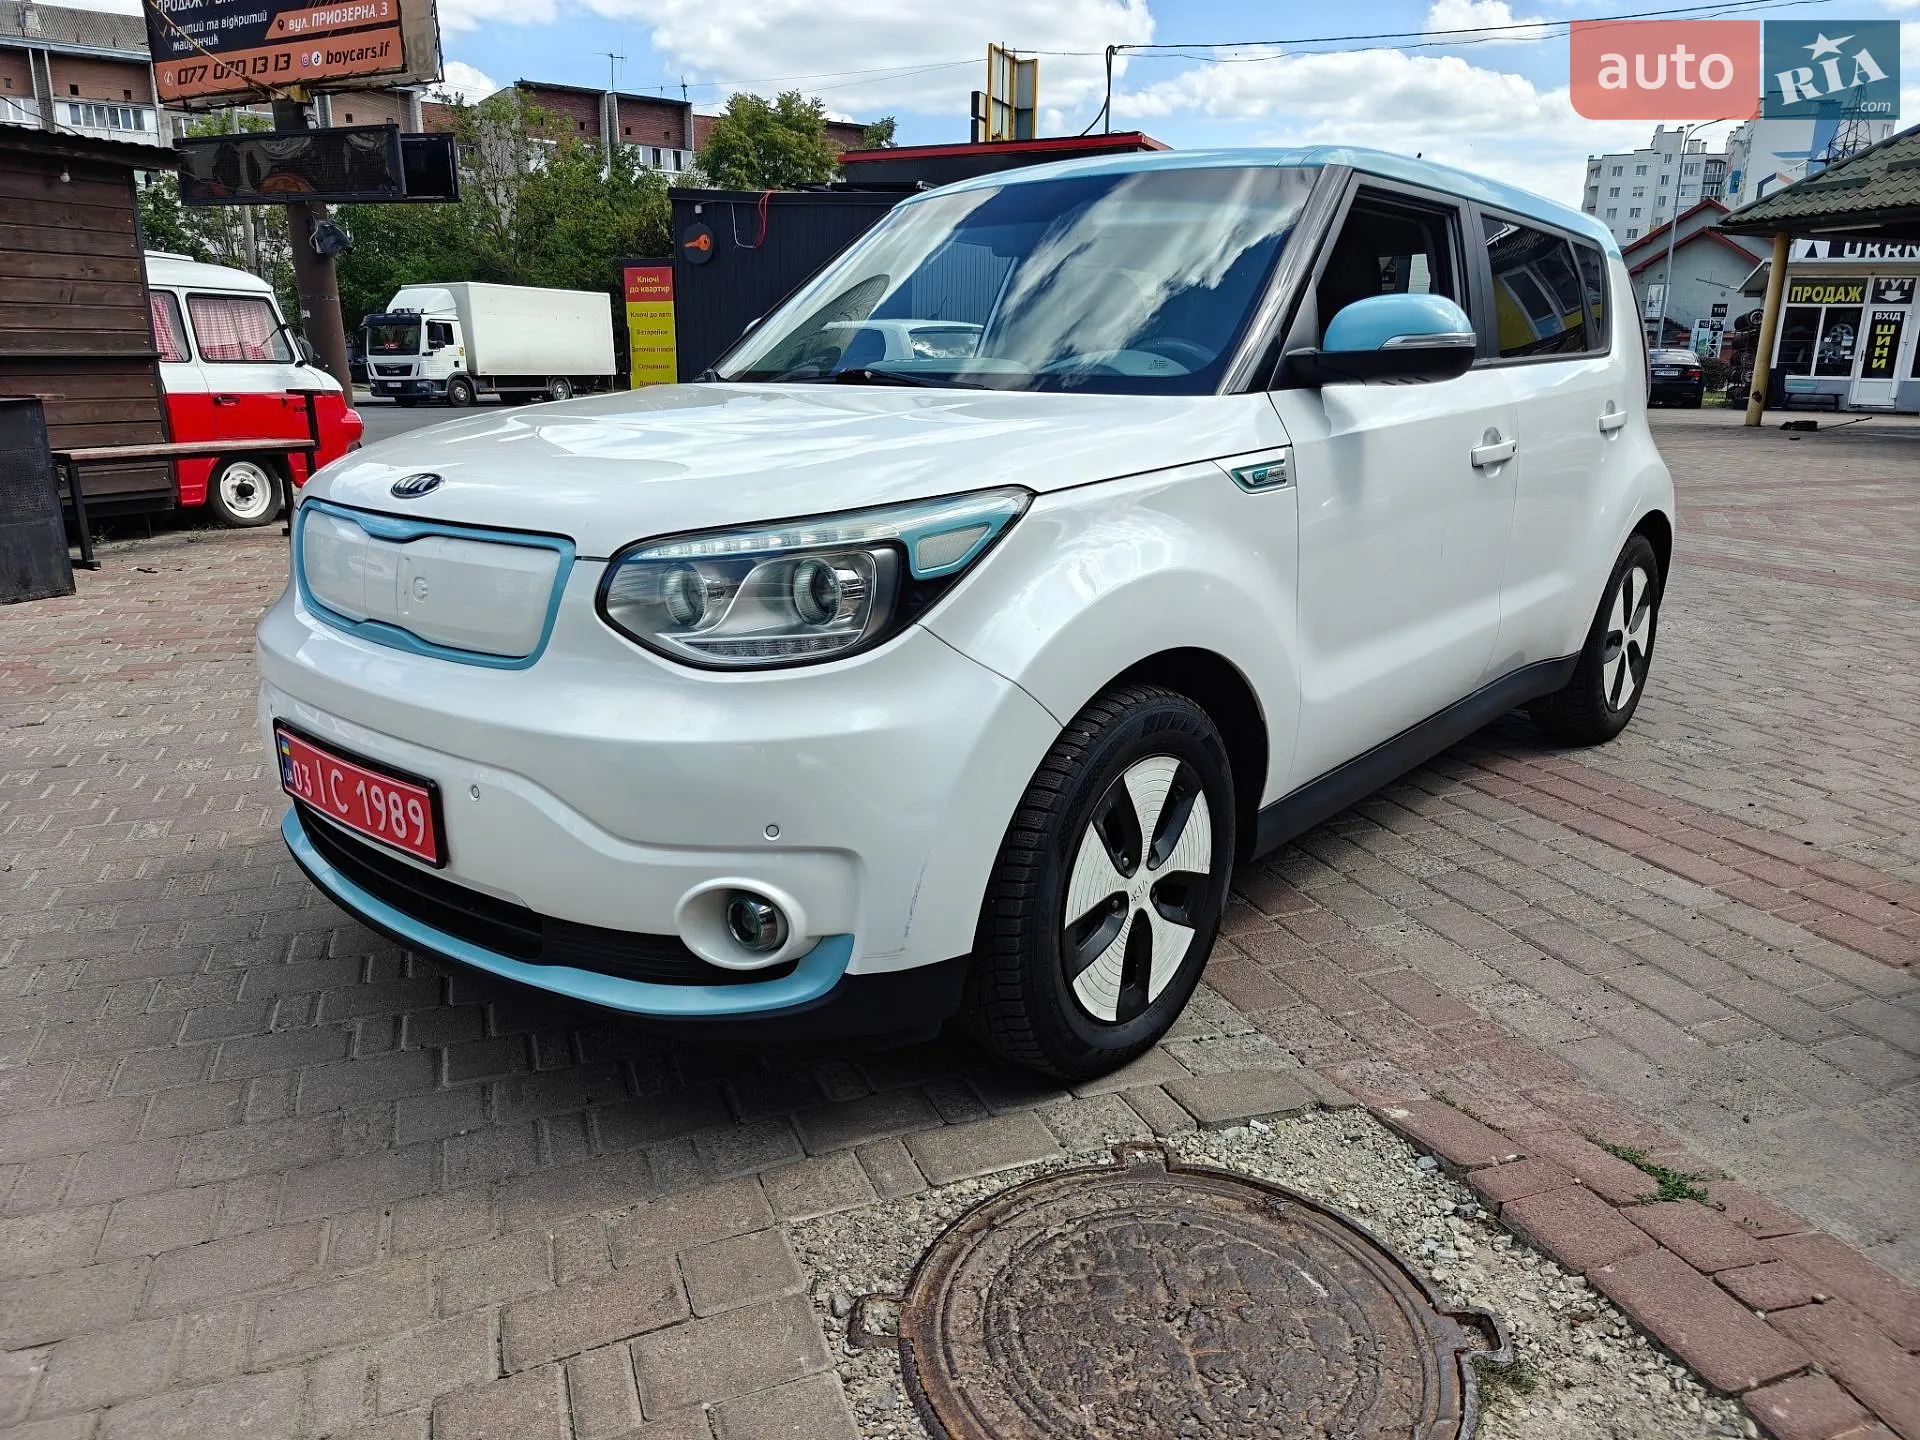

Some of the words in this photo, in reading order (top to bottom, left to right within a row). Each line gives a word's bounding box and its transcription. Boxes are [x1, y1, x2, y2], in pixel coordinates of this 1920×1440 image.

[206, 20, 219, 31] та
[221, 10, 268, 29] відкритий
[288, 18, 309, 32] вул.
[380, 2, 389, 16] 3
[326, 41, 391, 66] boycars.if
[177, 65, 209, 86] 077
[213, 59, 247, 80] 070
[251, 55, 268, 75] 13
[274, 53, 291, 72] 13
[637, 274, 660, 284] Ключі
[1879, 279, 1913, 291] ТУТ
[629, 286, 640, 294] до
[640, 286, 671, 294] квартир
[1790, 286, 1863, 304] ПРОДАЖ
[1875, 312, 1901, 321] ВХІД
[1871, 324, 1896, 368] ШИНИ
[393, 474, 437, 491] KIA
[293, 760, 313, 797] 03
[356, 780, 425, 846] 1989
